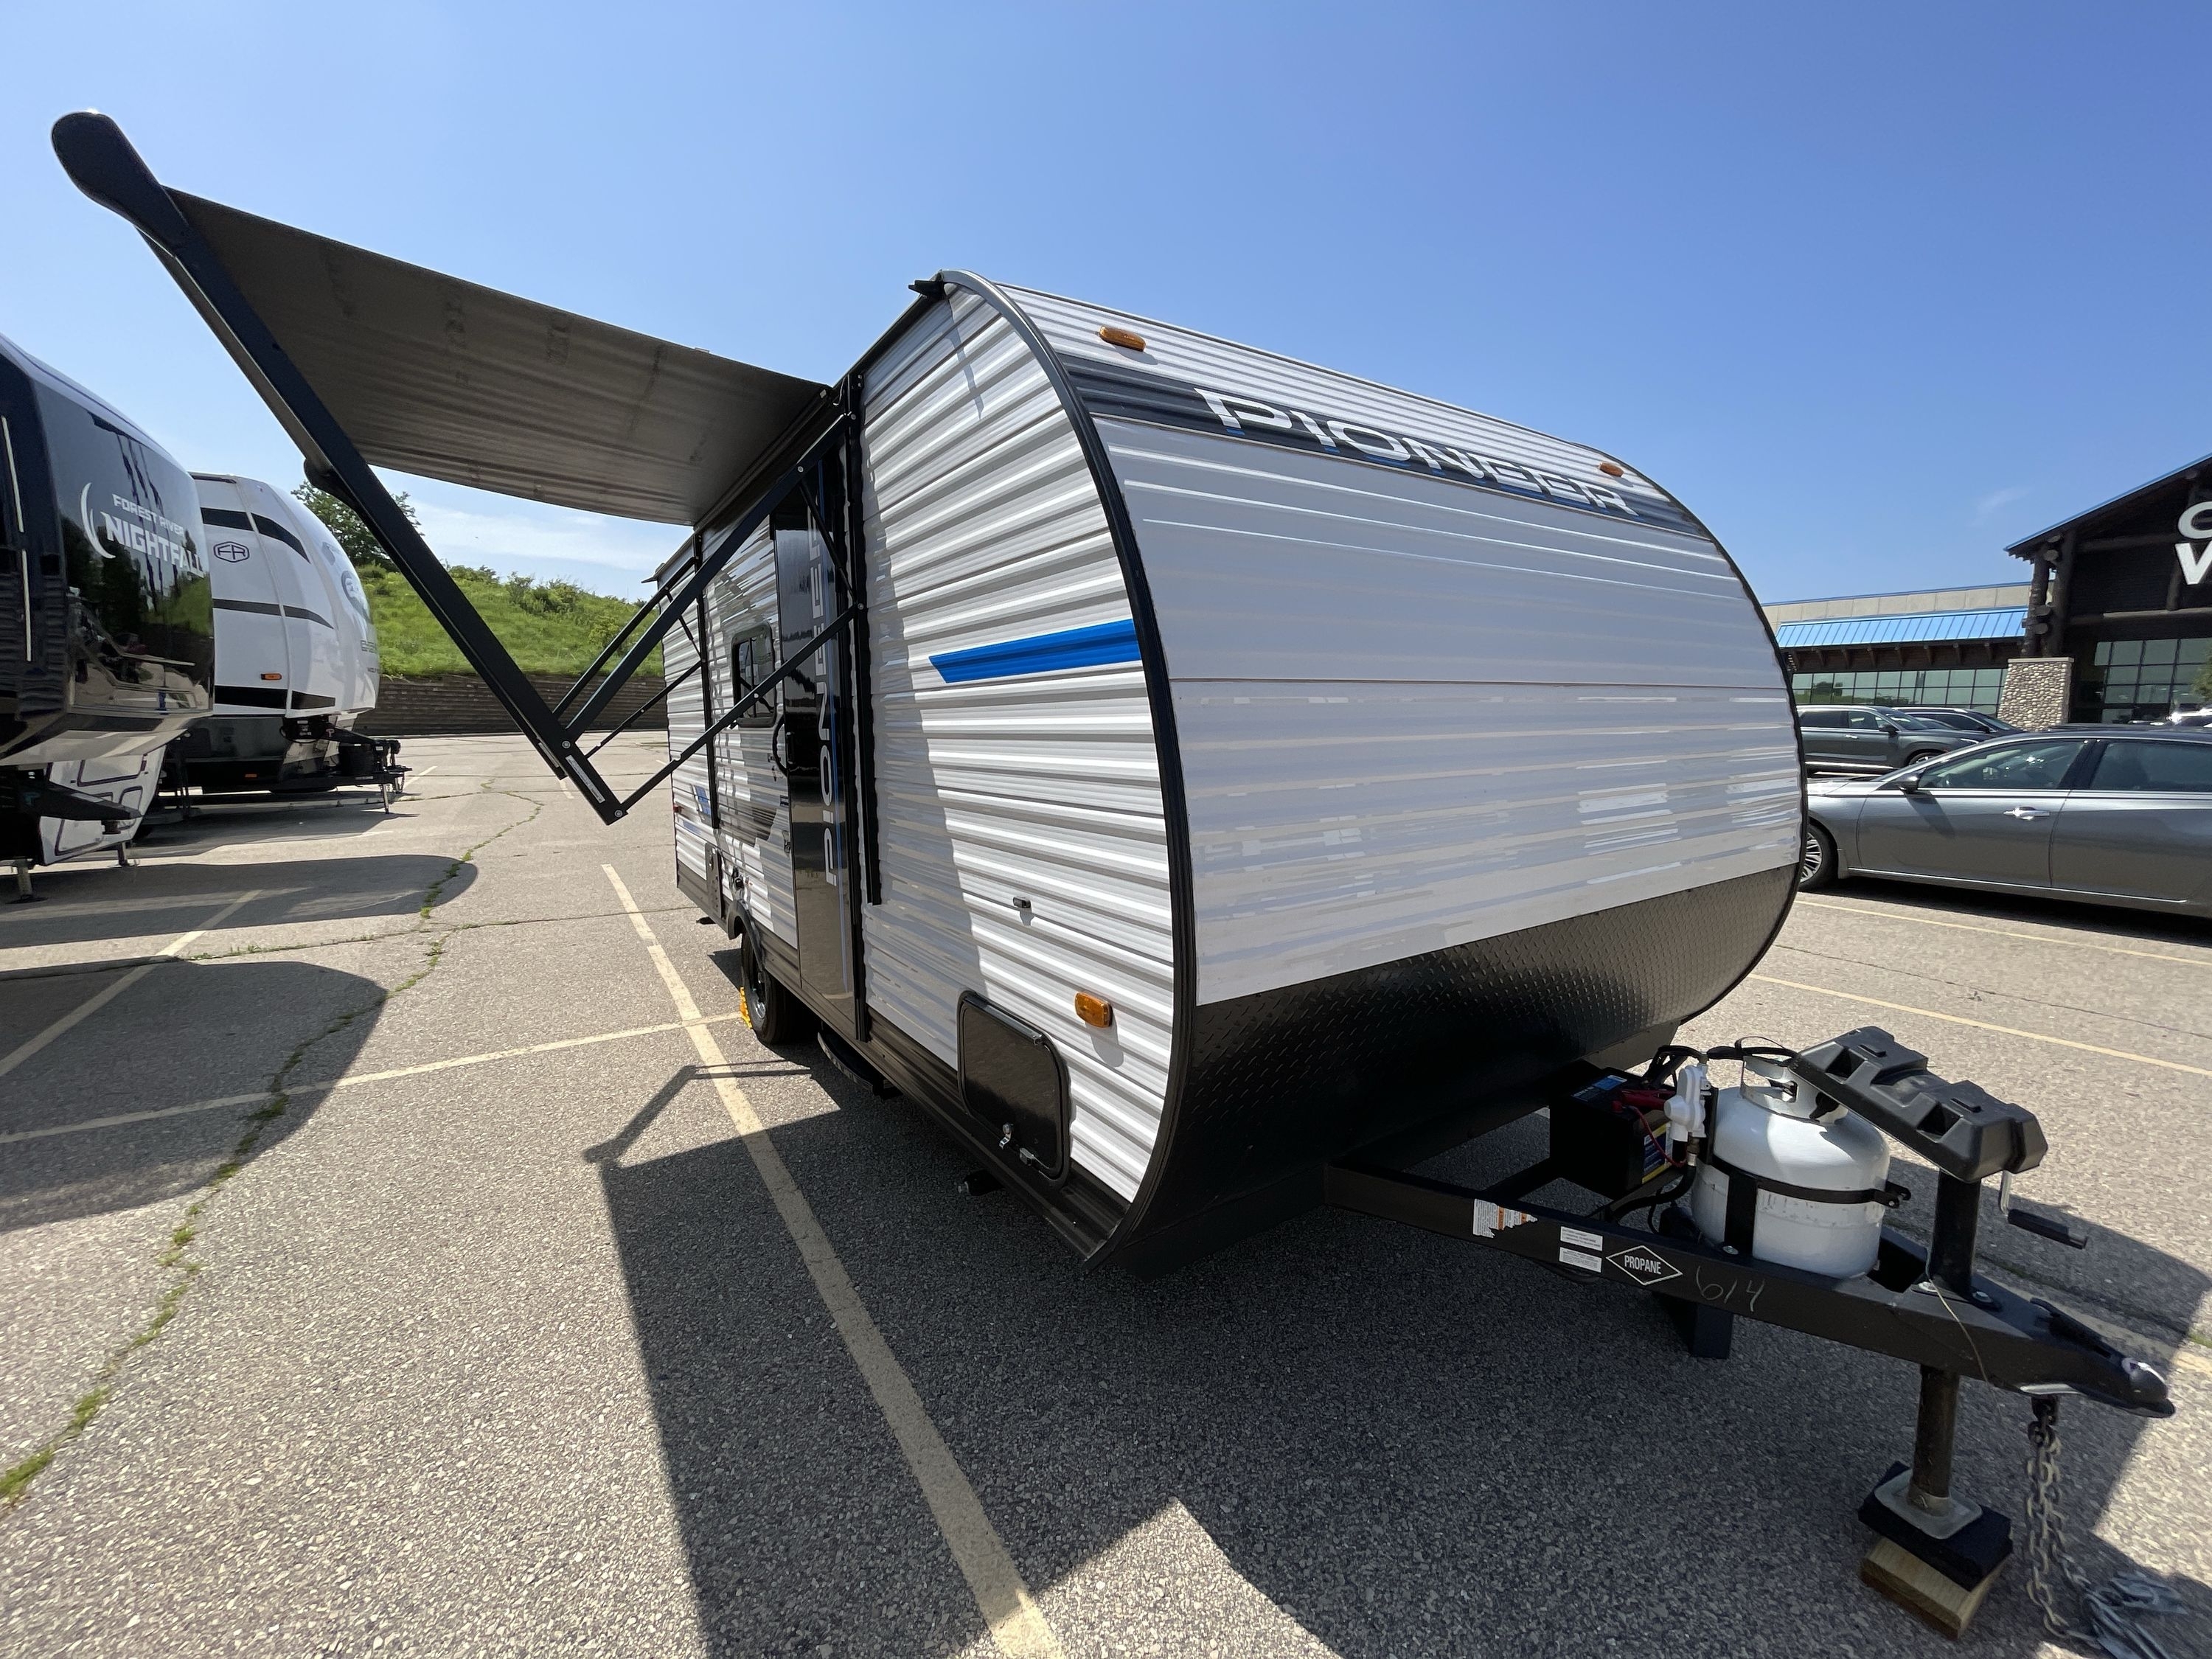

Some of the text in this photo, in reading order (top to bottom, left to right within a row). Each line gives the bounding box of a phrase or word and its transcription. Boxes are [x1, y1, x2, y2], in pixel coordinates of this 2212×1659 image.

[1194, 387, 1638, 517] PIONEER
[112, 494, 184, 536] FOREST RIVER
[100, 512, 205, 580] NIGHTFALL
[1624, 1255, 1661, 1274] PROPANE
[1696, 1265, 1764, 1312] 614
